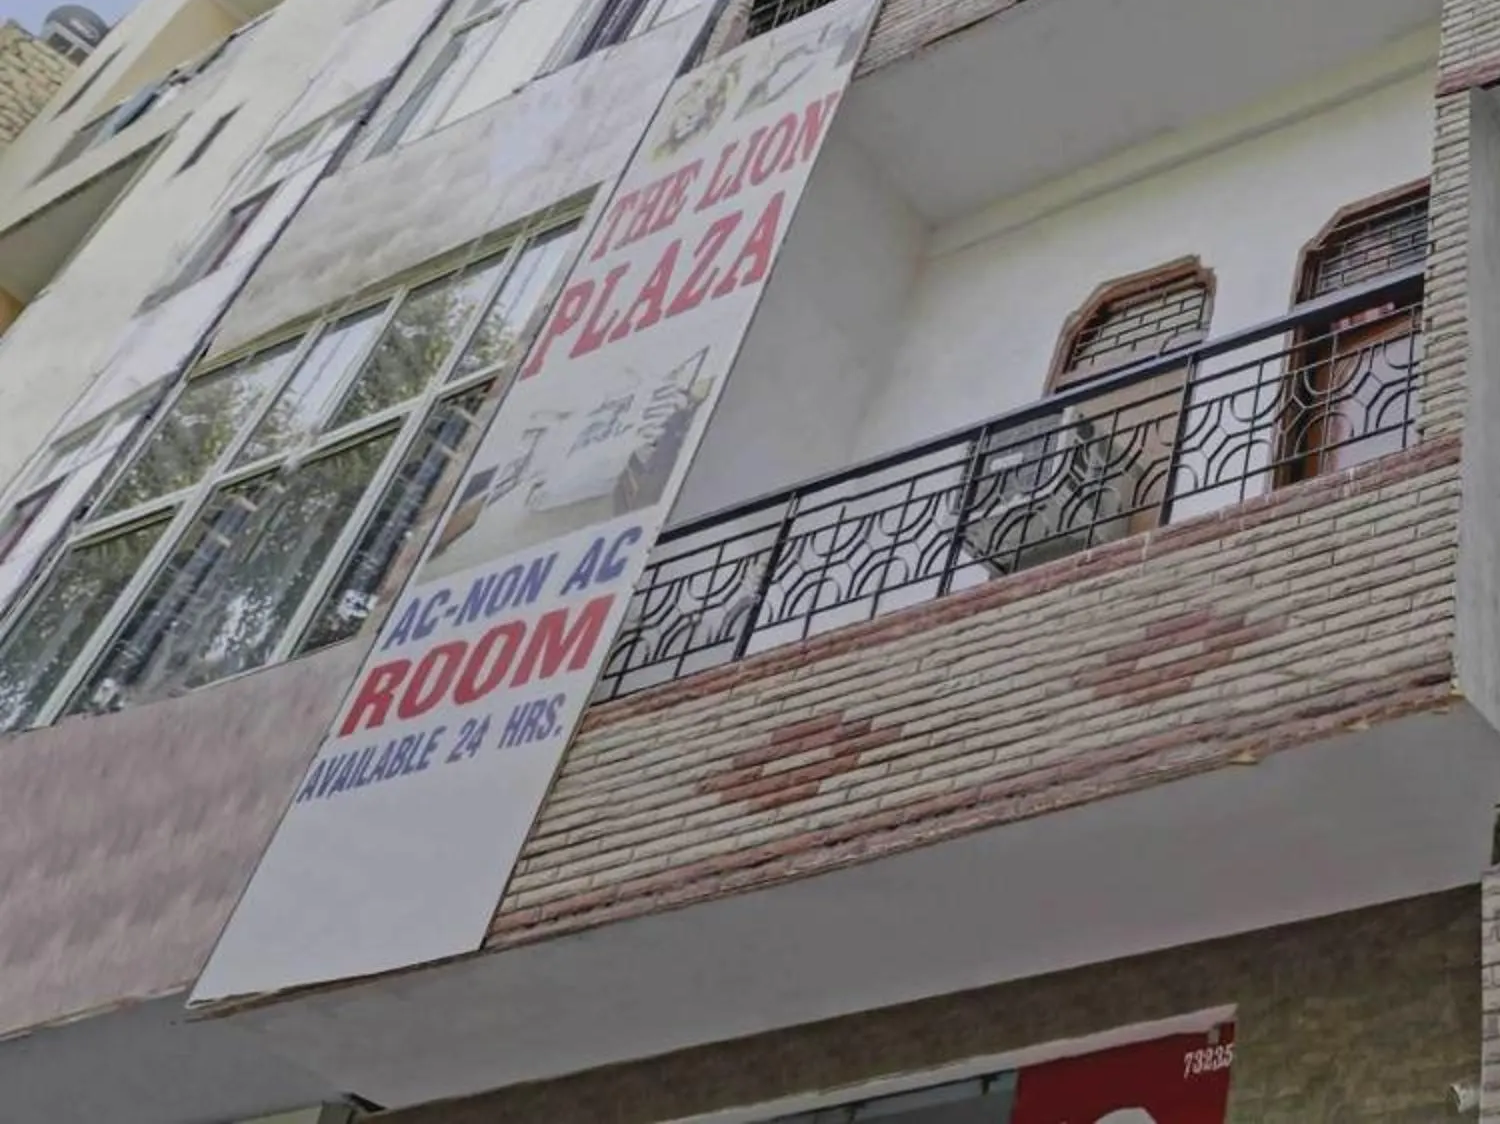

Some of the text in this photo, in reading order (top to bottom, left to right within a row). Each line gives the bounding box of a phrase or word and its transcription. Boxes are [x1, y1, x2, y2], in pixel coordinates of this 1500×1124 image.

[590, 90, 843, 262] THE LION
[519, 189, 786, 381] PLAZA
[381, 525, 643, 651] AC-NON AC
[338, 593, 616, 738] ROOM
[296, 693, 567, 804] AVAILABLE 24 HRS.
